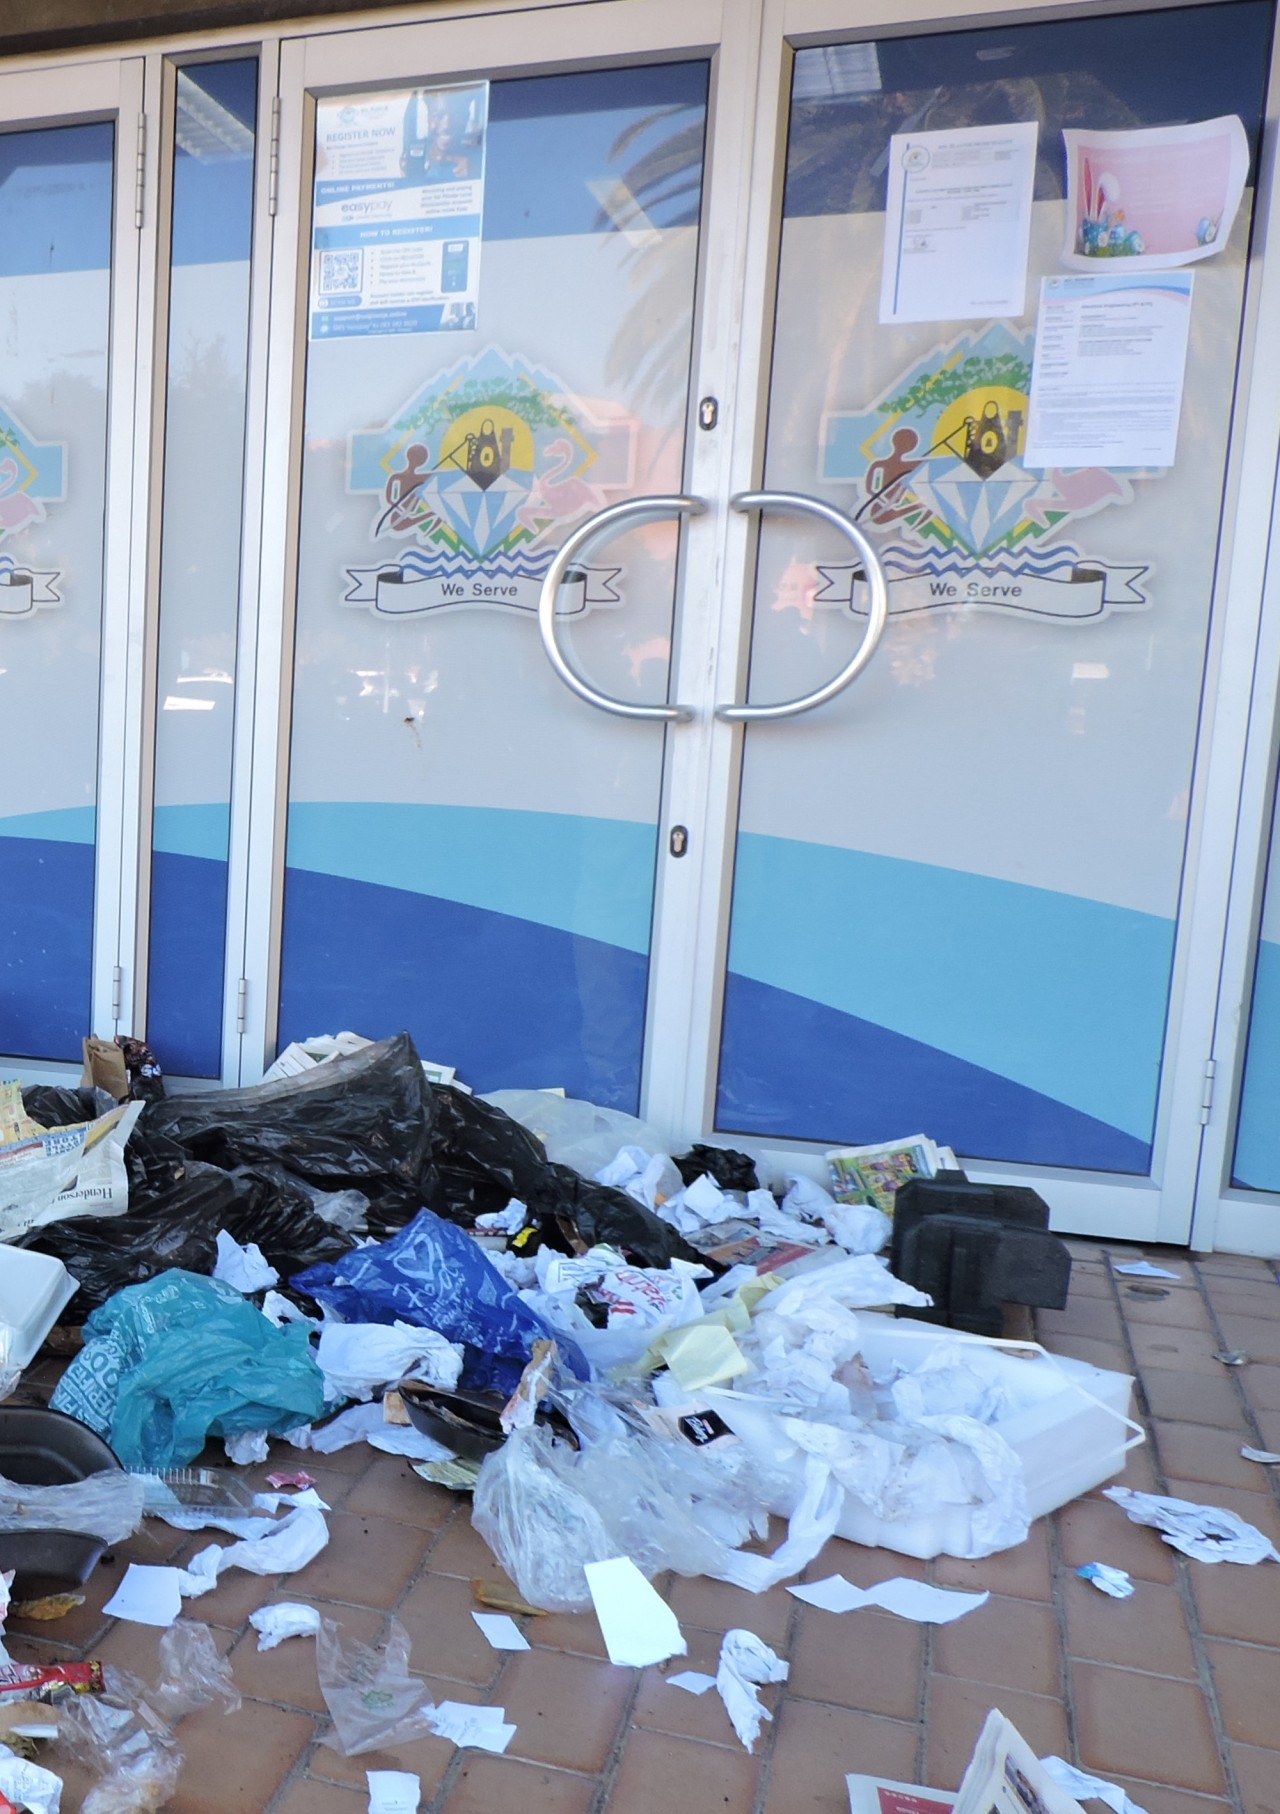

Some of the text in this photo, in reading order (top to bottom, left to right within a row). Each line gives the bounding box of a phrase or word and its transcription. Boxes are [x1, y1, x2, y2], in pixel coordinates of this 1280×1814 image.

[326, 127, 396, 142] REGISTER NOW
[321, 185, 350, 194] ONLINE
[341, 200, 393, 213] easypay
[380, 229, 390, 237] TO
[441, 583, 519, 596] We Serve
[929, 582, 1023, 597] We Serve
[56, 1186, 114, 1203] Henderson
